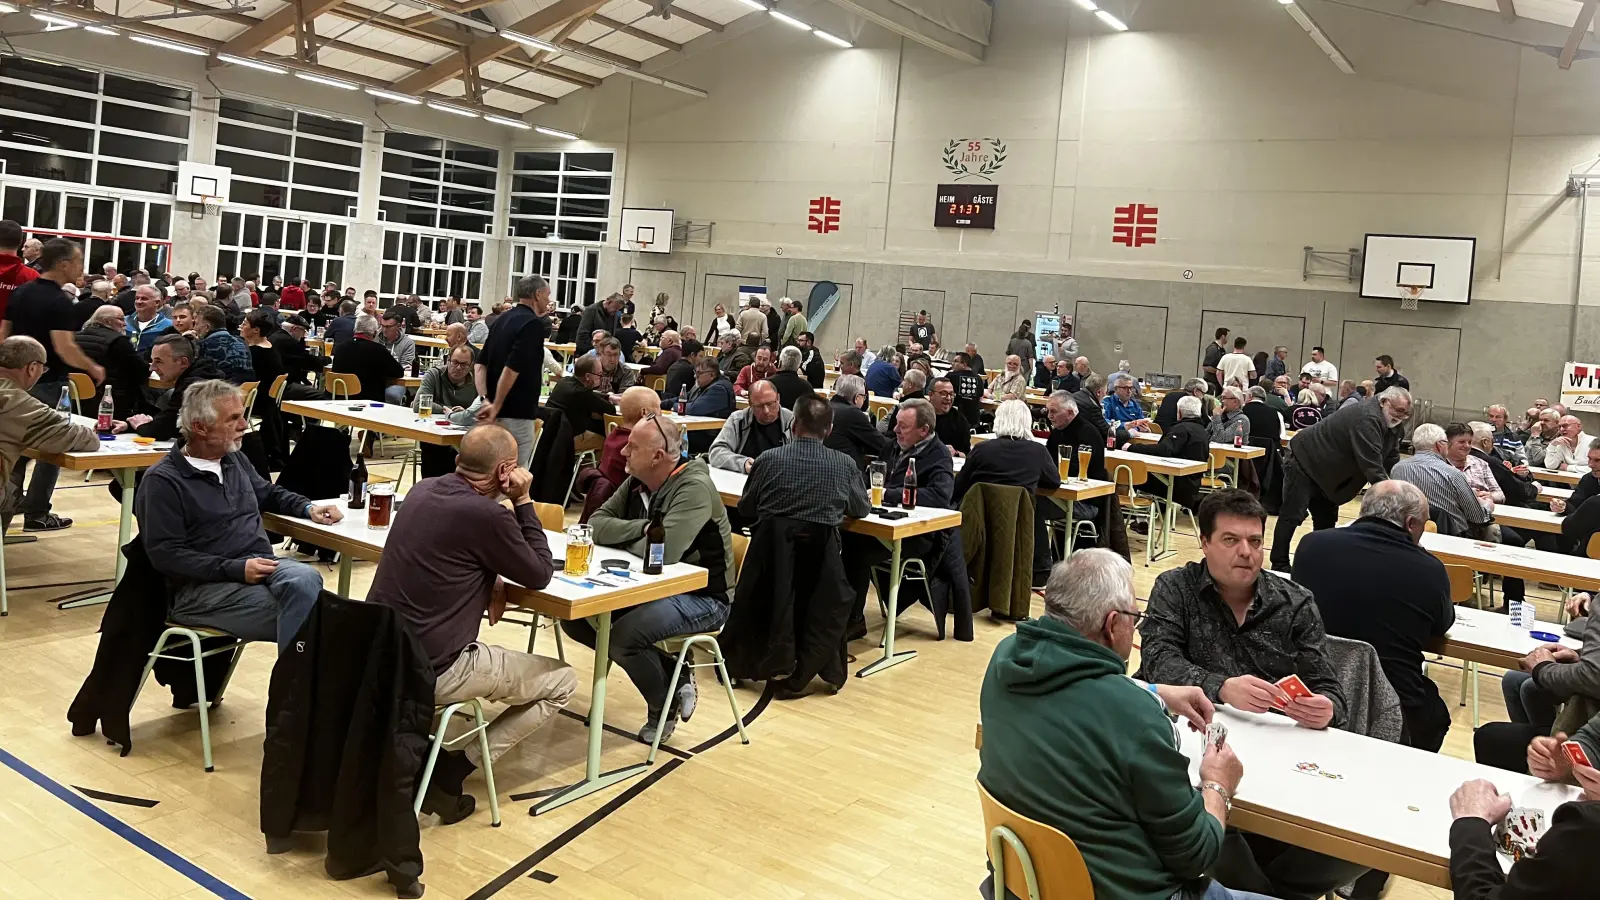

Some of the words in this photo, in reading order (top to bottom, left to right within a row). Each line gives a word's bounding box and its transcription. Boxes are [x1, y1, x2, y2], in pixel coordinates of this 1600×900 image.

[968, 142, 980, 151] 55
[960, 152, 989, 162] Jahre
[939, 195, 955, 203] HEIM
[973, 194, 993, 204] GÄSTE
[1570, 373, 1600, 389] WI
